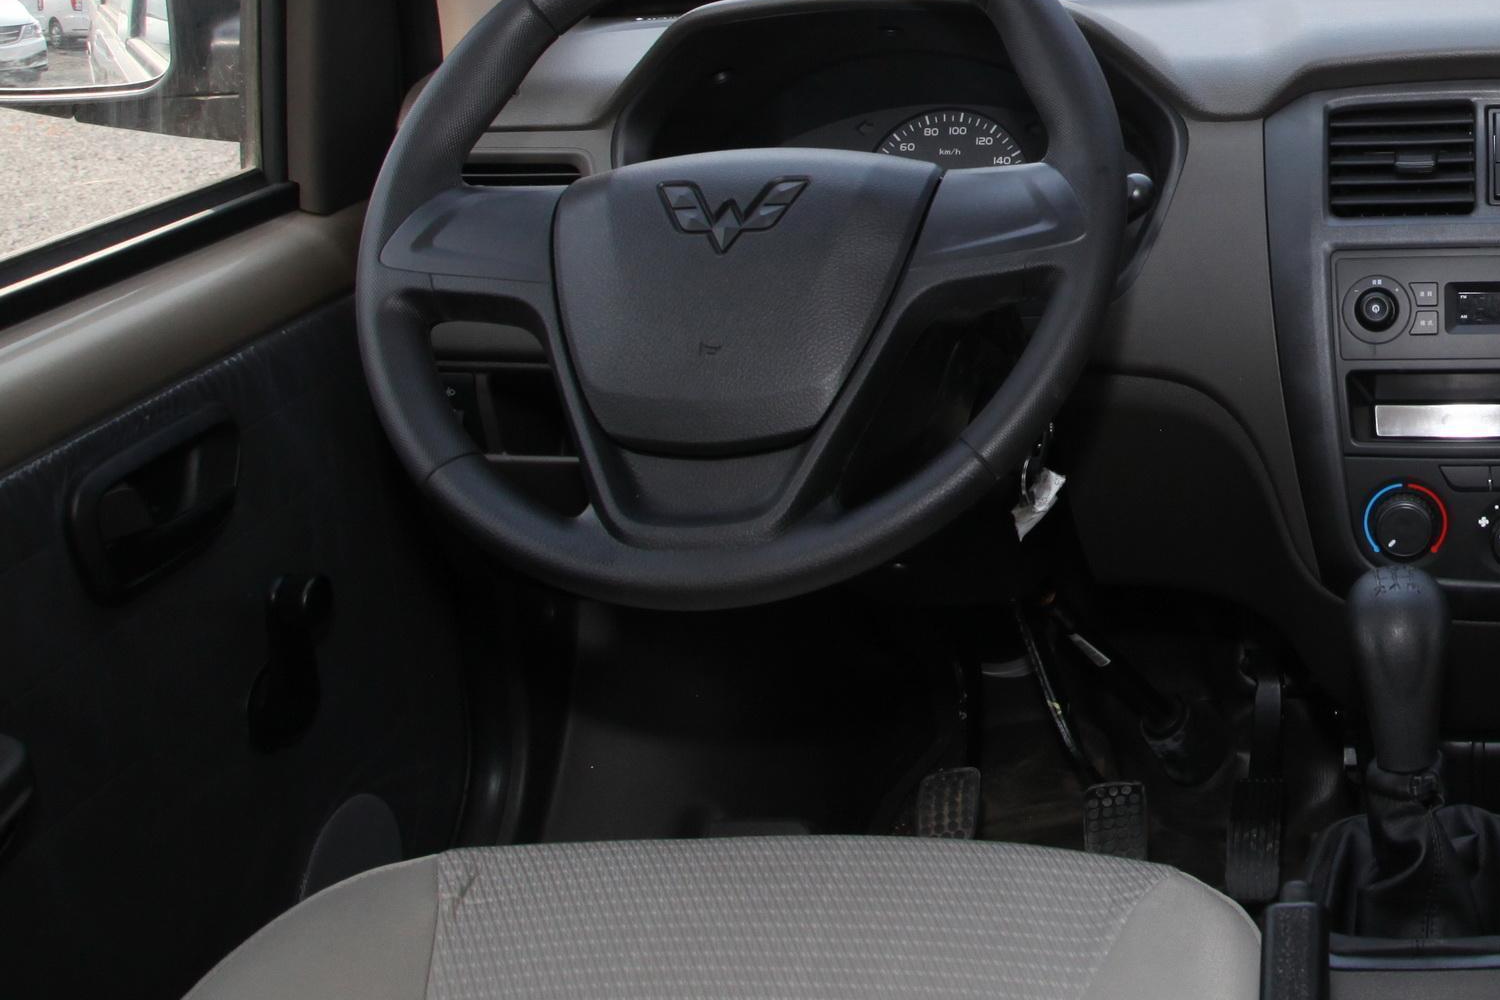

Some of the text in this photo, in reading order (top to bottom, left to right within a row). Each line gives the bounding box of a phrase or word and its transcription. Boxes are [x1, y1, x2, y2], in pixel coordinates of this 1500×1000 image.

[924, 127, 967, 136] 80 100
[976, 137, 993, 145] 120
[900, 143, 915, 151] 60
[993, 156, 1011, 164] 140
